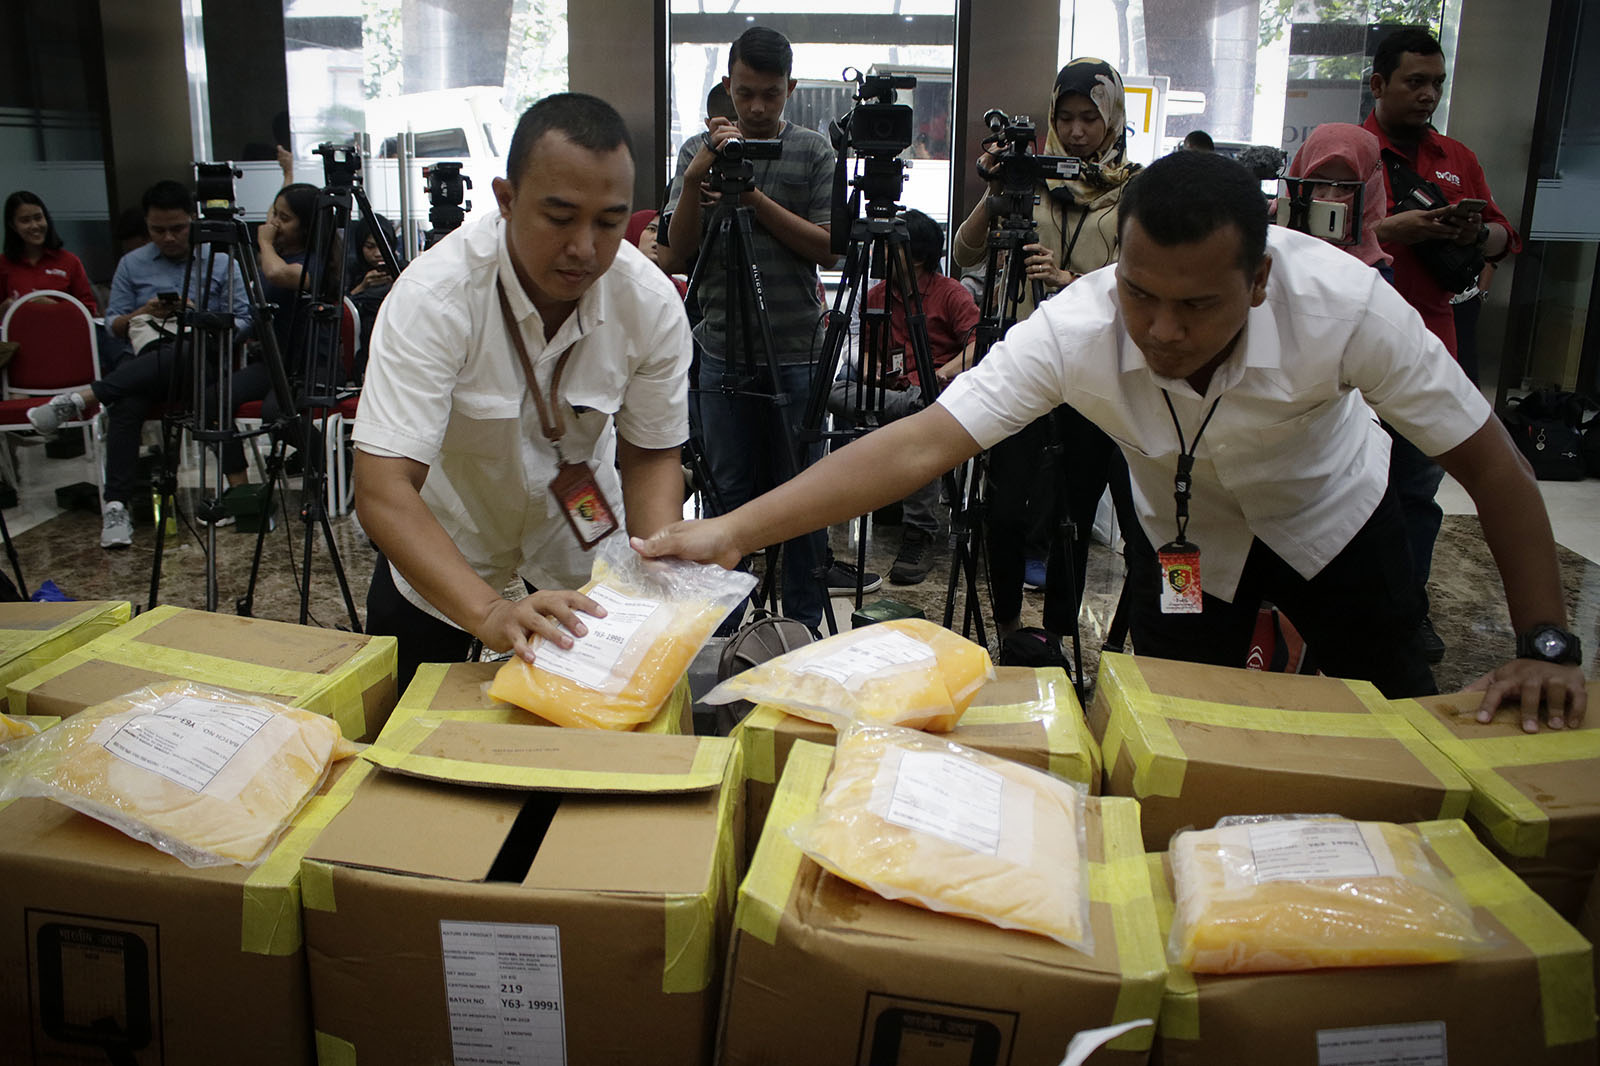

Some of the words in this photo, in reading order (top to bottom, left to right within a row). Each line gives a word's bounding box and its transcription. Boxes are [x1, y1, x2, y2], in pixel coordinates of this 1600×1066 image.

[501, 984, 523, 994] 219
[501, 999, 525, 1009] Y63-
[528, 1000, 559, 1011] 19991
